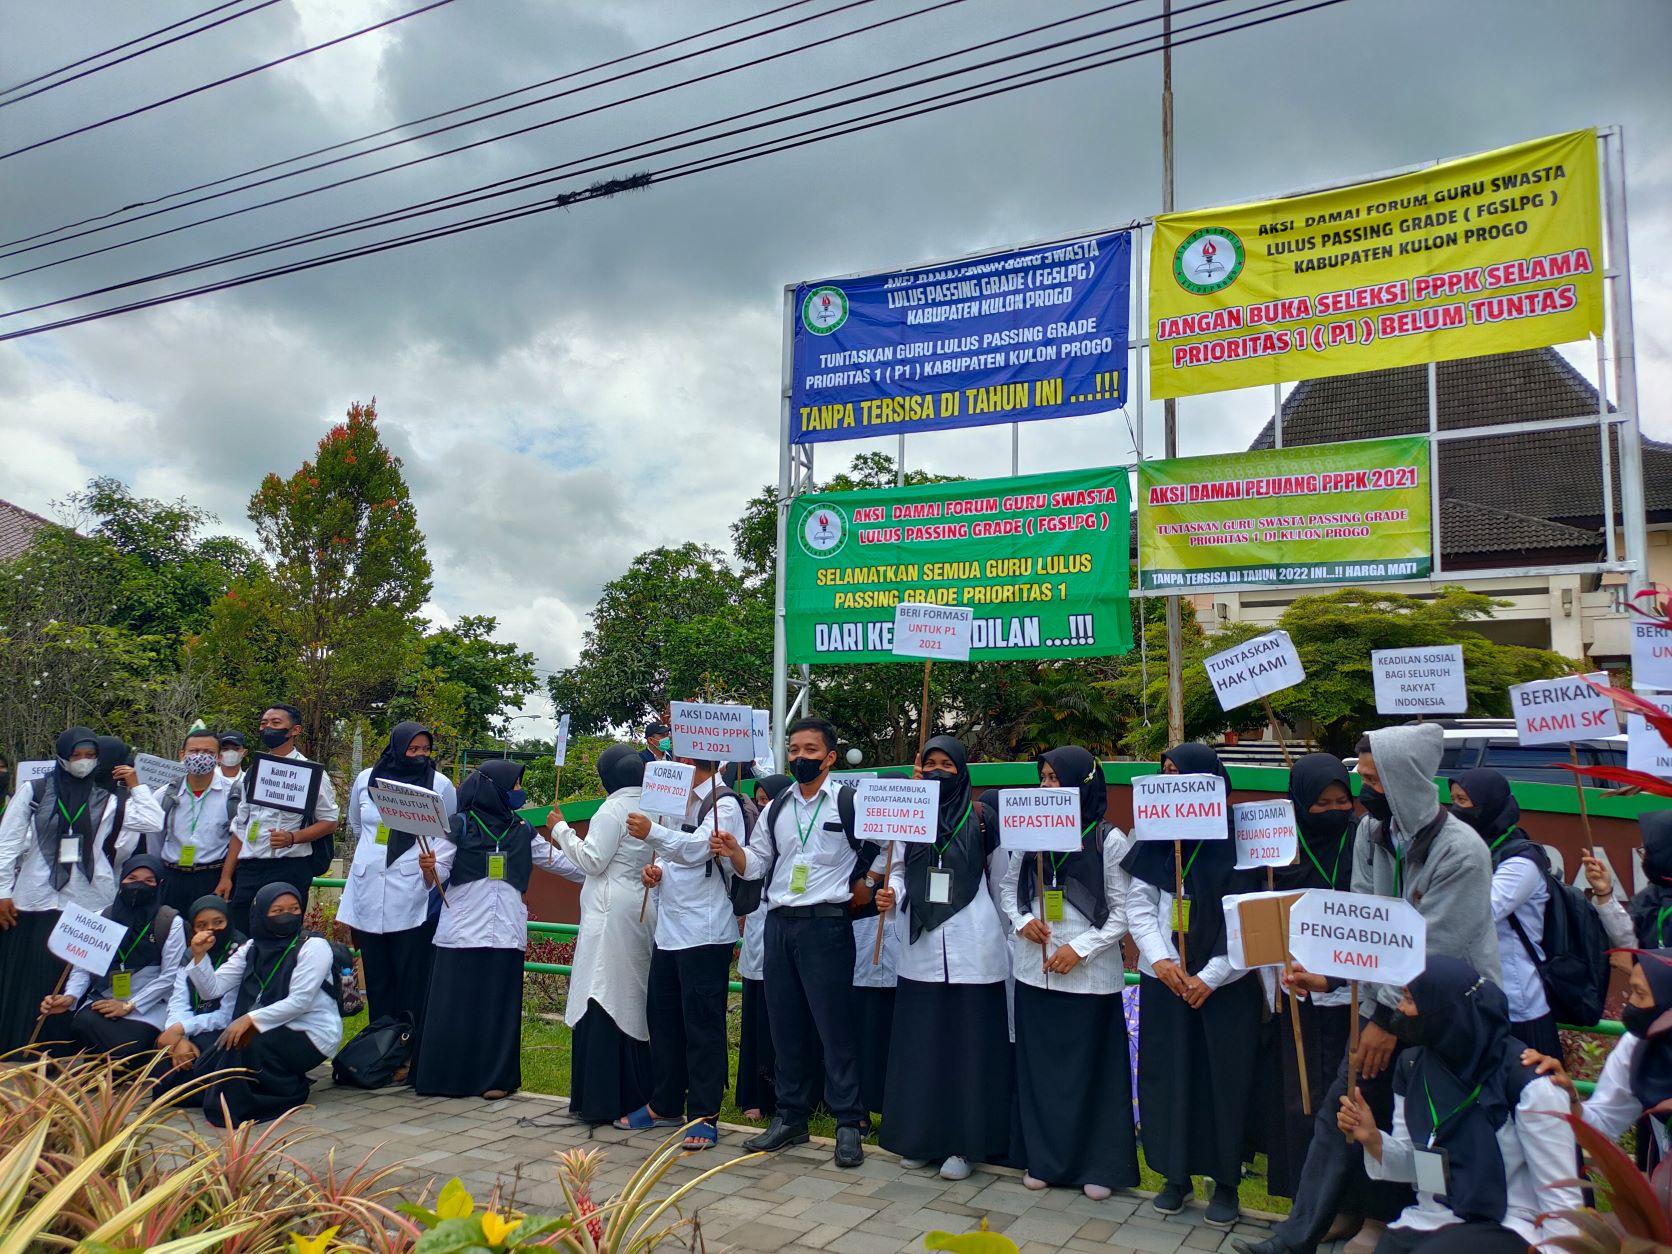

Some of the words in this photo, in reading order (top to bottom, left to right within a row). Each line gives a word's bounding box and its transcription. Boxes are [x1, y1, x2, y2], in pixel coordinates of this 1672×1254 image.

[1259, 220, 1294, 236] AKSI
[1305, 208, 1360, 228] DAMAI
[1366, 194, 1428, 216] FORUM
[1434, 180, 1485, 203] GURU
[1490, 164, 1566, 192] SWASTA
[1267, 236, 1316, 256] LULUS
[1322, 222, 1393, 248] PASSING
[1399, 210, 1457, 232] GRADE
[1477, 193, 1544, 218] FGSLPG
[1294, 245, 1393, 274] KABUPATEN
[1399, 232, 1457, 256] KULON
[1464, 220, 1528, 244] PROGO
[888, 288, 924, 308] LULUS
[927, 279, 980, 303] PASSING
[982, 272, 1024, 296] GRADE
[1159, 307, 1243, 339] JANGAN
[1248, 297, 1312, 326] BUKA
[1316, 280, 1408, 316] SELEKSI
[1414, 268, 1482, 300] PPPK
[1486, 250, 1592, 288] SELAMA
[907, 302, 979, 326] KABUPATEN
[982, 294, 1023, 316] KULON
[1026, 287, 1072, 308] PROGO
[1174, 332, 1291, 368] PRIORITAS
[1295, 328, 1306, 350] 1
[1329, 321, 1356, 344] P1
[1378, 302, 1466, 338] BELUM
[1470, 285, 1576, 324] TUNTAS
[820, 347, 893, 368] TUNTASKAN
[896, 342, 932, 358] GURU
[936, 335, 979, 354] LULUS
[984, 326, 1043, 348] PASSING
[1047, 318, 1096, 338] GRADE
[806, 369, 870, 390] PRIORITAS
[874, 368, 882, 382] 1
[924, 353, 1005, 376] KABUPATEN
[1010, 345, 1056, 365] KULON
[1062, 338, 1112, 358] PROGO
[800, 403, 856, 431] TANPA
[861, 394, 934, 426] TERSISA
[940, 392, 960, 418] DI
[966, 382, 1028, 414] TAHUN
[1036, 378, 1062, 406] INI
[1149, 485, 1186, 505] AKSI
[1188, 480, 1242, 502] DAMAI
[1244, 475, 1318, 498] PEJUANG
[1320, 470, 1368, 492] PPPK
[1370, 466, 1418, 489] 2021
[854, 507, 885, 523] AKSI
[892, 502, 940, 520] DAMAI
[945, 498, 998, 516] FORUM
[1002, 494, 1047, 512] GURU
[1051, 487, 1116, 508] SWASTA
[859, 528, 902, 545] LULUS
[905, 523, 968, 542] PASSING
[972, 519, 1022, 538] GRADE
[1038, 513, 1096, 532] FGSLPG
[1157, 521, 1218, 535] TUNTASKAN
[1222, 519, 1254, 532] GURU
[1258, 516, 1304, 530] SWASTA
[1308, 512, 1361, 526] PASSING
[1365, 510, 1408, 522] GRADE
[1190, 534, 1248, 547] PRIORITAS
[1253, 532, 1260, 543] 1
[1264, 530, 1278, 542] DI
[1280, 529, 1322, 540] KULON
[1325, 526, 1370, 538] PROGO
[816, 564, 918, 586] SELAMATKAN
[922, 561, 981, 581] SEMUA
[986, 557, 1032, 578] GURU
[1037, 554, 1092, 574] LULUS
[1152, 573, 1184, 585] TANPA
[1186, 571, 1228, 584] TERSISA
[1230, 570, 1240, 582] DI
[1243, 568, 1276, 580] TAHUN
[1280, 567, 1308, 580] 2022
[1346, 564, 1385, 577] HARGA
[1388, 562, 1416, 574] MATI
[834, 590, 899, 608] PASSING
[904, 587, 958, 605] GRADE
[963, 582, 1052, 604] PRIORITAS
[1058, 582, 1067, 600] 1
[900, 608, 920, 618] BERI
[924, 610, 968, 622] FORMASI
[815, 622, 864, 652] DARI
[908, 624, 942, 634] UNTUK
[945, 626, 956, 636] P1
[920, 640, 942, 650] 2021
[1209, 638, 1280, 672] TUNTASKAN
[1378, 655, 1420, 666] KEADILAN
[1424, 654, 1456, 663] SOSIAL
[1216, 670, 1247, 691] HAK
[1248, 655, 1288, 678] KAMI
[1385, 670, 1406, 678] BAGI
[1408, 668, 1450, 678] SELURUH
[1400, 684, 1436, 692] RAKYAT
[1520, 684, 1601, 706] BERIKAN
[1395, 698, 1446, 706] INDONESIA
[680, 709, 702, 720] AKSI
[705, 711, 741, 722] DAMAI
[1527, 713, 1576, 732] KAMI
[1582, 710, 1606, 727] SK
[674, 724, 720, 736] PEJUANG
[722, 728, 750, 738] PPPK
[693, 742, 704, 750] P1
[708, 742, 731, 752] 2021
[654, 766, 682, 780] KORBAN
[869, 784, 887, 792] TIDAK
[889, 786, 926, 794] MEMBUKA
[1140, 780, 1216, 795] TUNTASKAN
[377, 794, 398, 805] KAMI
[400, 800, 430, 810] BUTUH
[864, 796, 912, 804] PENDAFTARAN
[1006, 796, 1032, 806] KAMI
[1034, 795, 1072, 806] BUTUH
[379, 806, 436, 824] KEPASTIAN
[866, 808, 910, 818] SEBELUM
[913, 810, 924, 818] P1
[1138, 804, 1170, 819] HAK
[1175, 802, 1222, 818] KAMI
[1240, 809, 1257, 822] AKSI
[1258, 806, 1286, 819] DAMAI
[864, 824, 884, 832] 2021
[887, 824, 926, 834] TUNTAS
[1004, 815, 1076, 828] KEPASTIAN
[1237, 827, 1270, 841] PEJUANG
[1272, 826, 1294, 837] PPPK
[1250, 848, 1260, 859] P1
[1262, 847, 1280, 858] 2021
[1324, 901, 1389, 922] HARGAI
[75, 914, 107, 934] HARGAI
[60, 922, 112, 952] PENGABDIAN
[1301, 922, 1414, 949] PENGABDIAN
[66, 942, 88, 958] KAMI
[1334, 950, 1378, 968] KAMI
